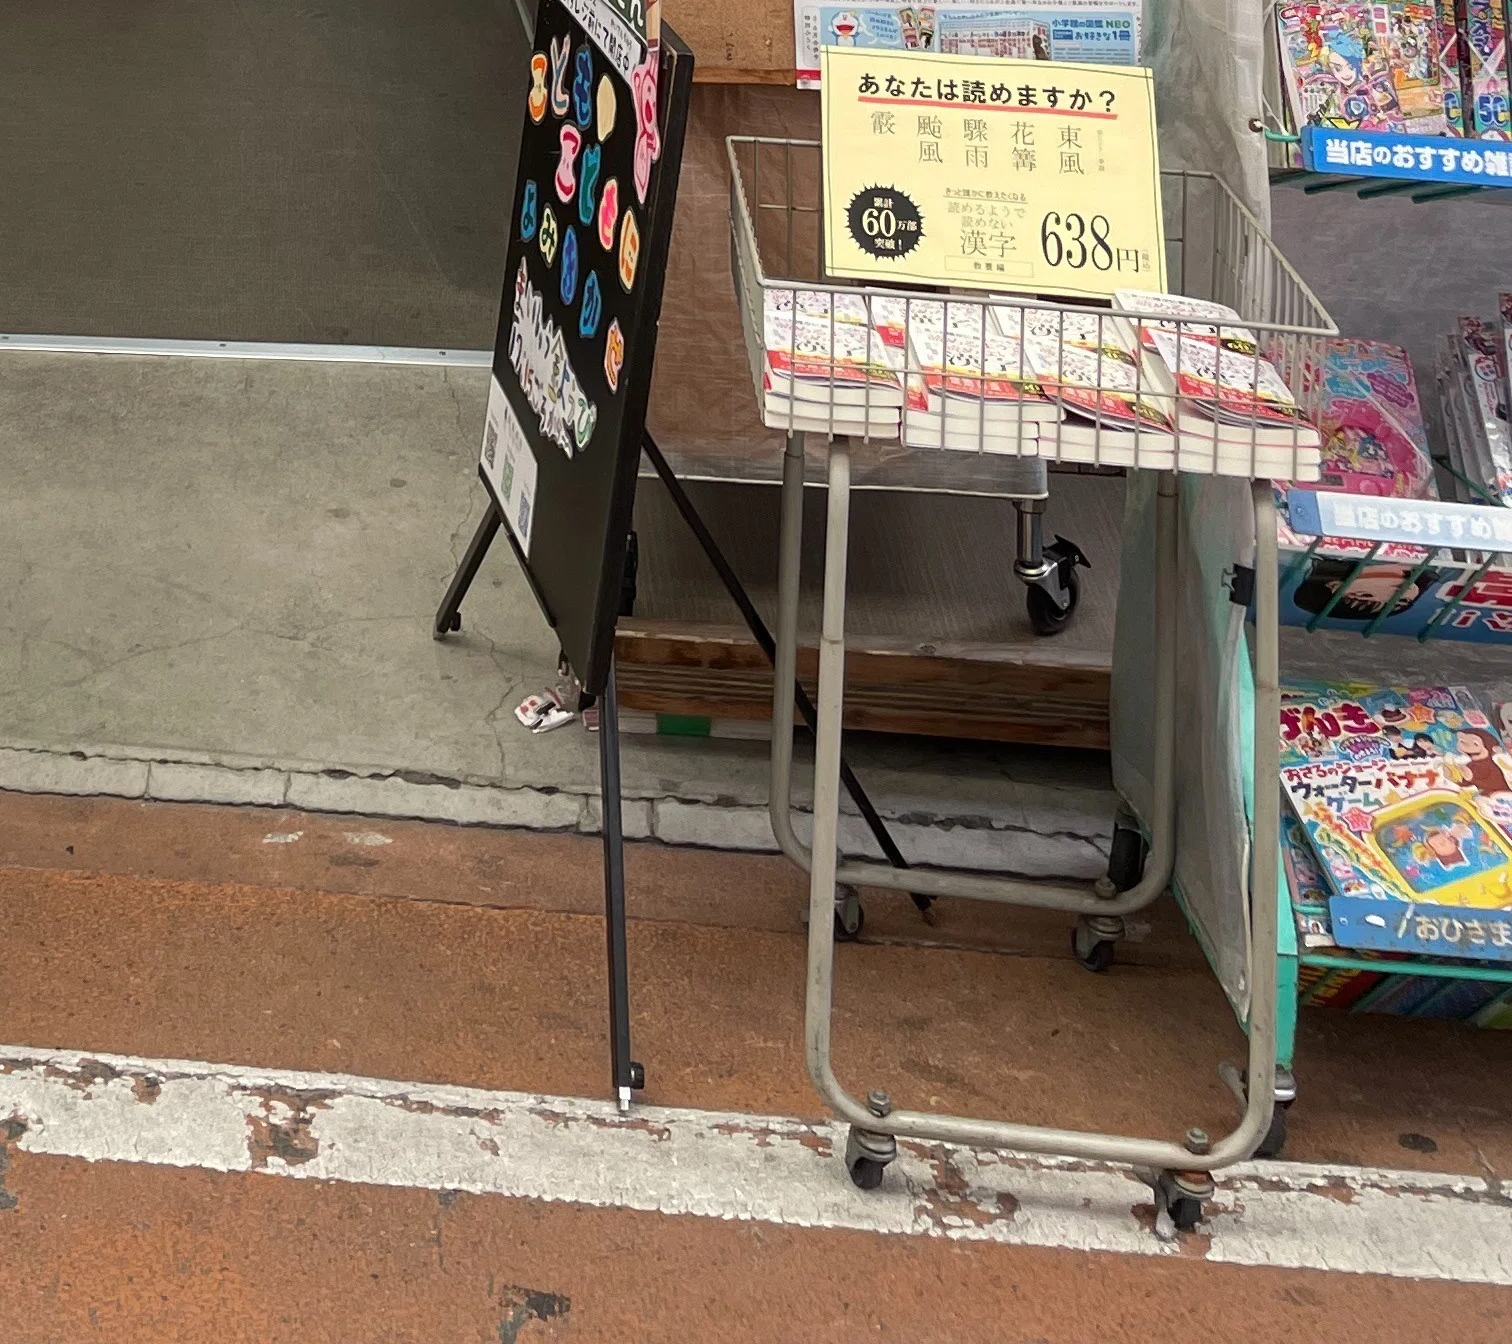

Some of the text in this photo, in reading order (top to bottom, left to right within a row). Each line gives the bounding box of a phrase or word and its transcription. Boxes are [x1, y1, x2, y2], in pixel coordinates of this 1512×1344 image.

[1105, 19, 1131, 29] NEO
[858, 71, 1118, 113] あなたは読めますか?
[1057, 124, 1085, 176] 東風
[947, 201, 1028, 218] 読めるようで
[960, 215, 1014, 229] 読めない
[862, 208, 918, 239] 60万部
[874, 238, 905, 252] 突破!
[960, 227, 1018, 259] 漢字
[1040, 211, 1140, 274] 638円
[1283, 759, 1388, 783] おさるのジョージ
[1290, 768, 1439, 800] ウォーターバナナ
[1326, 791, 1384, 813] ゲーム
